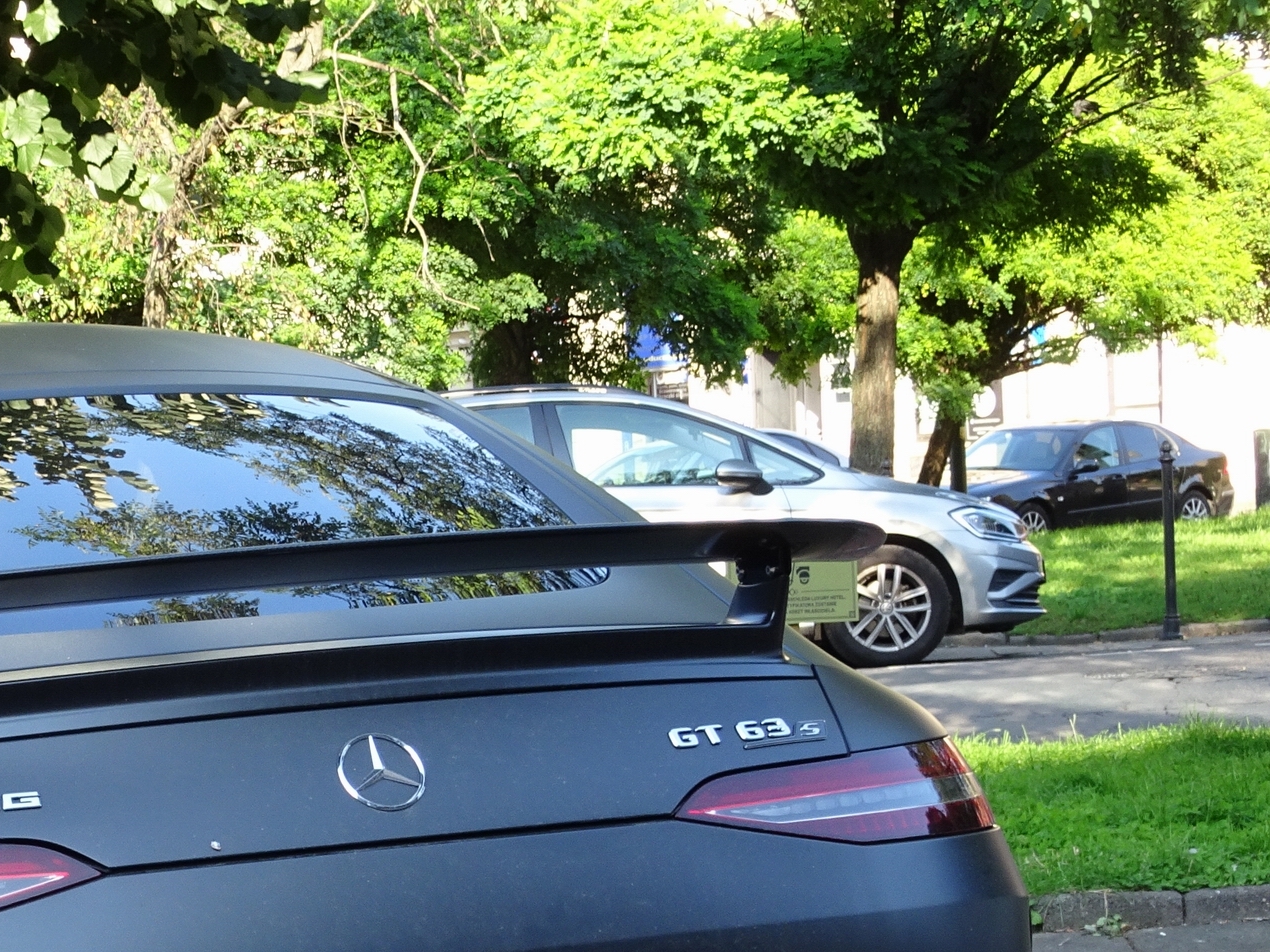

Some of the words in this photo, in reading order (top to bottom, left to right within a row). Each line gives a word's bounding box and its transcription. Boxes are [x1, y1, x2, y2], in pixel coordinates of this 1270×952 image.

[668, 724, 723, 748] GT
[735, 717, 792, 741] 63
[799, 722, 821, 736] S
